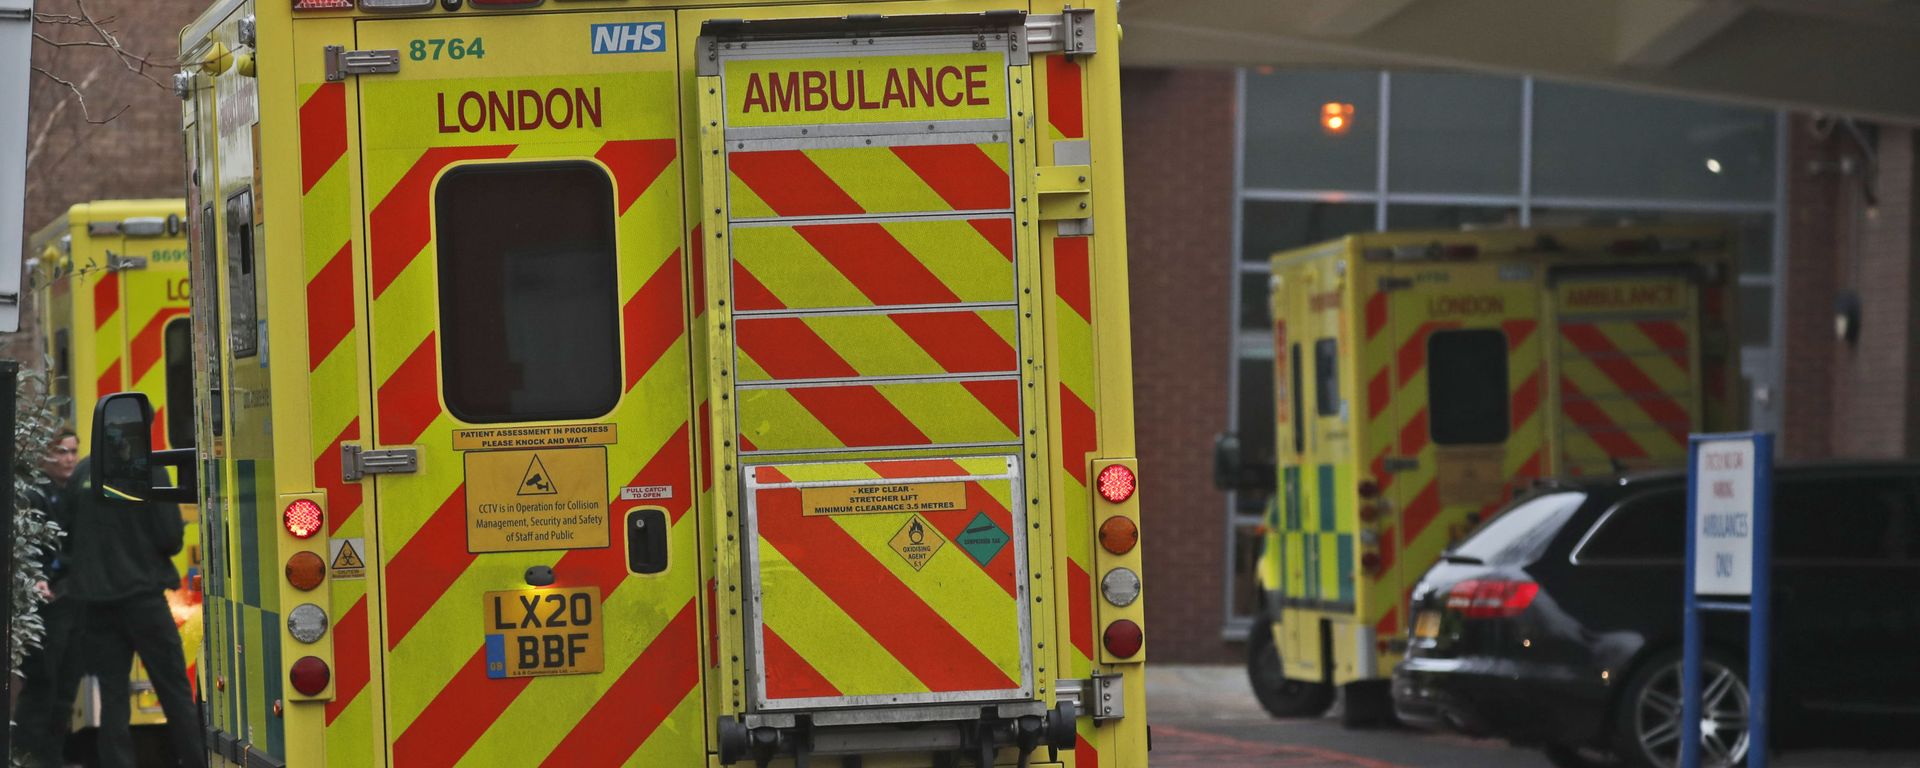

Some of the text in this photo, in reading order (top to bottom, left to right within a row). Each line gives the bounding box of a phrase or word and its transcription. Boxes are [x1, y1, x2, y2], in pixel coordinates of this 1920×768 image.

[409, 24, 662, 61] 8764 NHS
[742, 65, 990, 113] AMBULANCE
[437, 87, 602, 133] LONDON
[460, 430, 494, 438] PATIENT
[496, 428, 551, 437] ASSESSMENT
[564, 426, 608, 434] PROGRESS
[482, 436, 588, 447] PLEASE KNOCK AND WAIT
[849, 495, 898, 503] STRETCHER
[479, 501, 599, 514] CCTV is in Operation for Collision
[814, 506, 853, 514] MINIMUM
[855, 504, 904, 512] CLEARANCE
[476, 514, 603, 530] Management, Security and Safety
[506, 530, 574, 542] of Staff and Public
[494, 592, 592, 629] LX20
[517, 633, 589, 669] BBF
